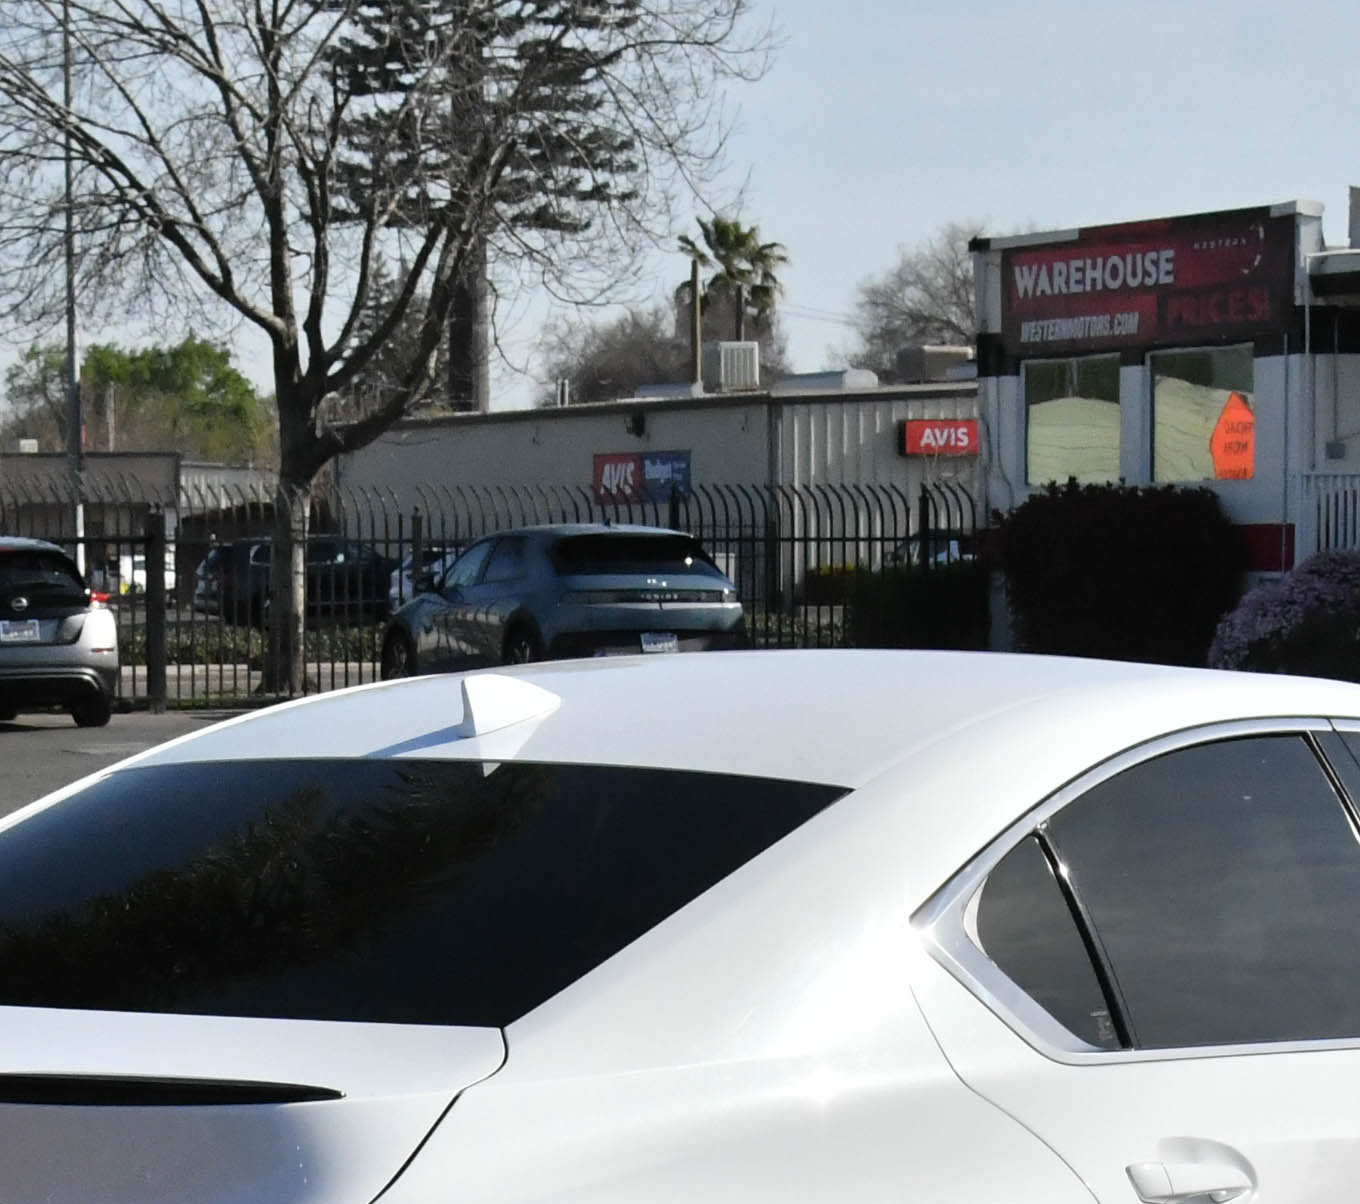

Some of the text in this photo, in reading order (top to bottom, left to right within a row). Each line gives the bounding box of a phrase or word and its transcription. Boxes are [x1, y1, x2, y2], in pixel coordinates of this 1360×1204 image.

[1013, 249, 1175, 299] WAREHOUSE
[920, 427, 969, 447] AVIS
[600, 461, 635, 495] AVIS
